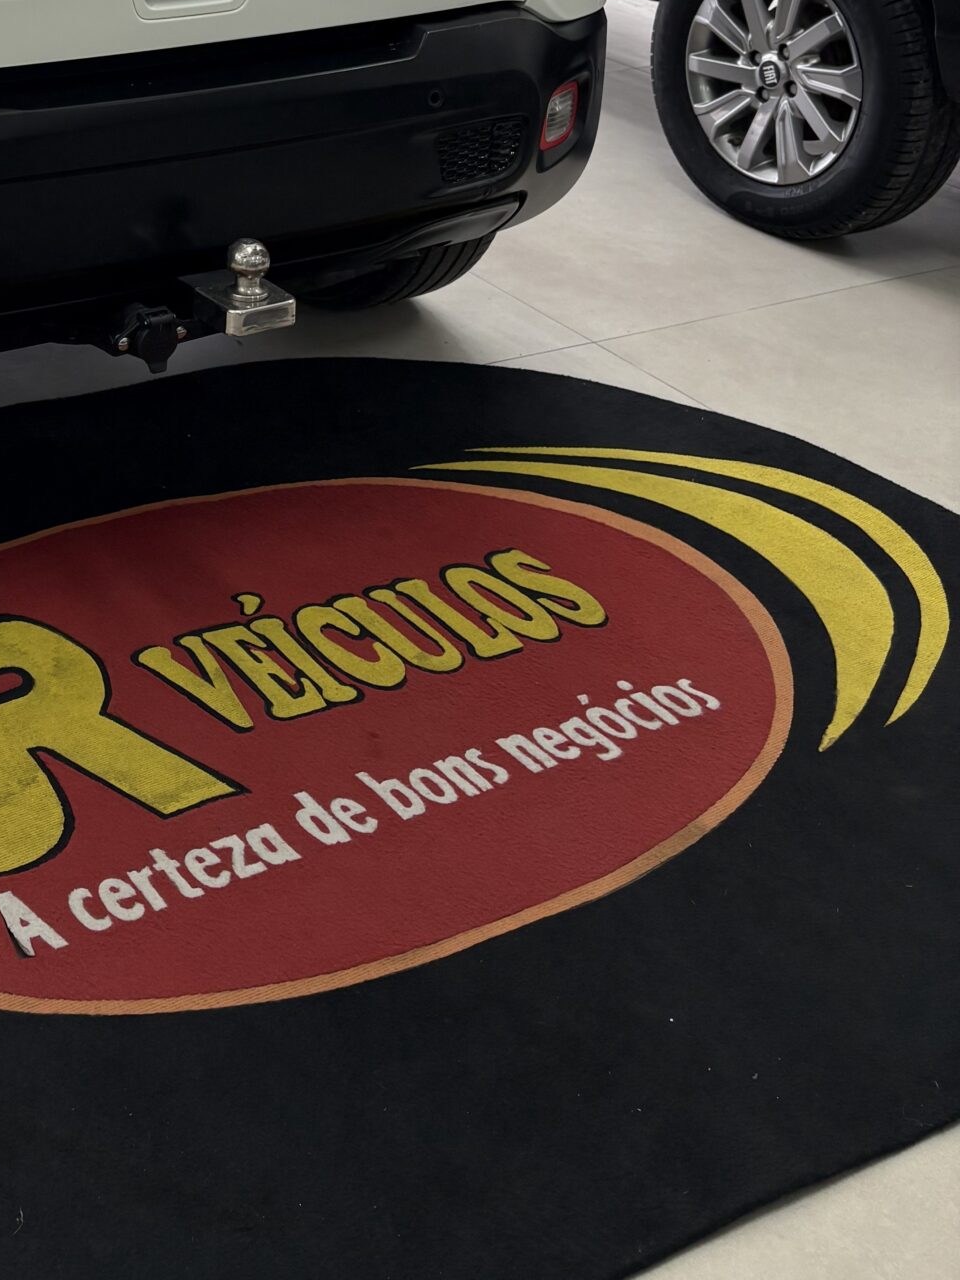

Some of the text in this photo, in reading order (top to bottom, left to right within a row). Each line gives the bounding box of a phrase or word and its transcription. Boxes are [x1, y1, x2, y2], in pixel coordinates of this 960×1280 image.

[762, 65, 777, 84] FIAT
[131, 547, 609, 734] VEÍCULOS
[68, 823, 303, 932] certeza
[294, 791, 379, 847] de
[355, 746, 510, 821] bons
[495, 678, 722, 774] negócios
